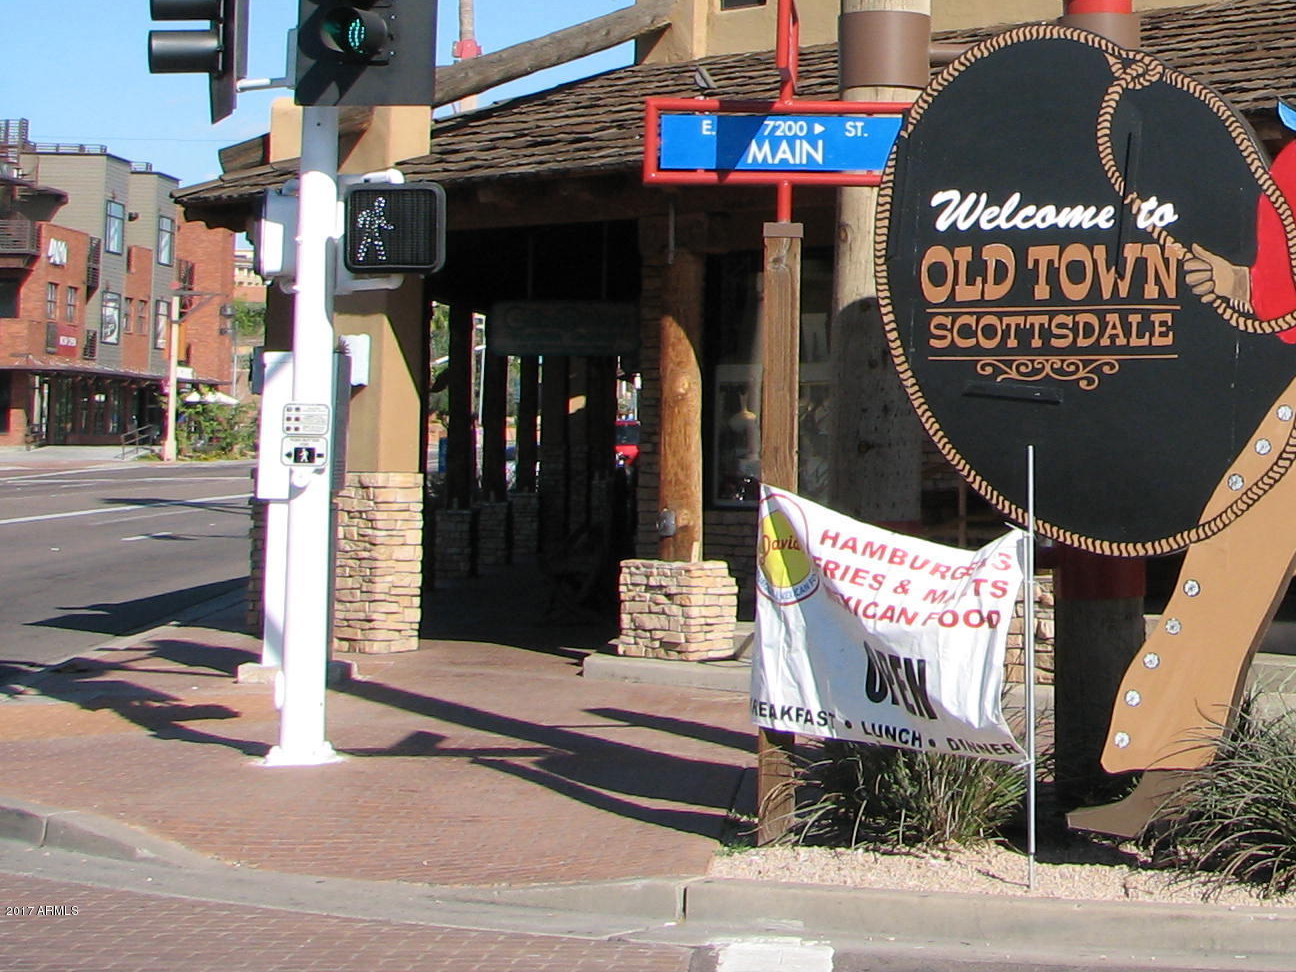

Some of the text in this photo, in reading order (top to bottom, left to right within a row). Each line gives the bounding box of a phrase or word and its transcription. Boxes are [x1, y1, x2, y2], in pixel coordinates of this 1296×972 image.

[701, 120, 869, 137] E. 7200 ST.
[747, 139, 824, 165] MAIN
[930, 189, 1178, 231] Welcome to
[920, 242, 1181, 304] OLD TOWN
[929, 313, 1175, 348] SCOTTSDALE
[892, 579, 911, 596] &
[863, 640, 938, 719] OPEN
[861, 721, 922, 748] LUNCH
[946, 737, 1020, 755] DINNER
